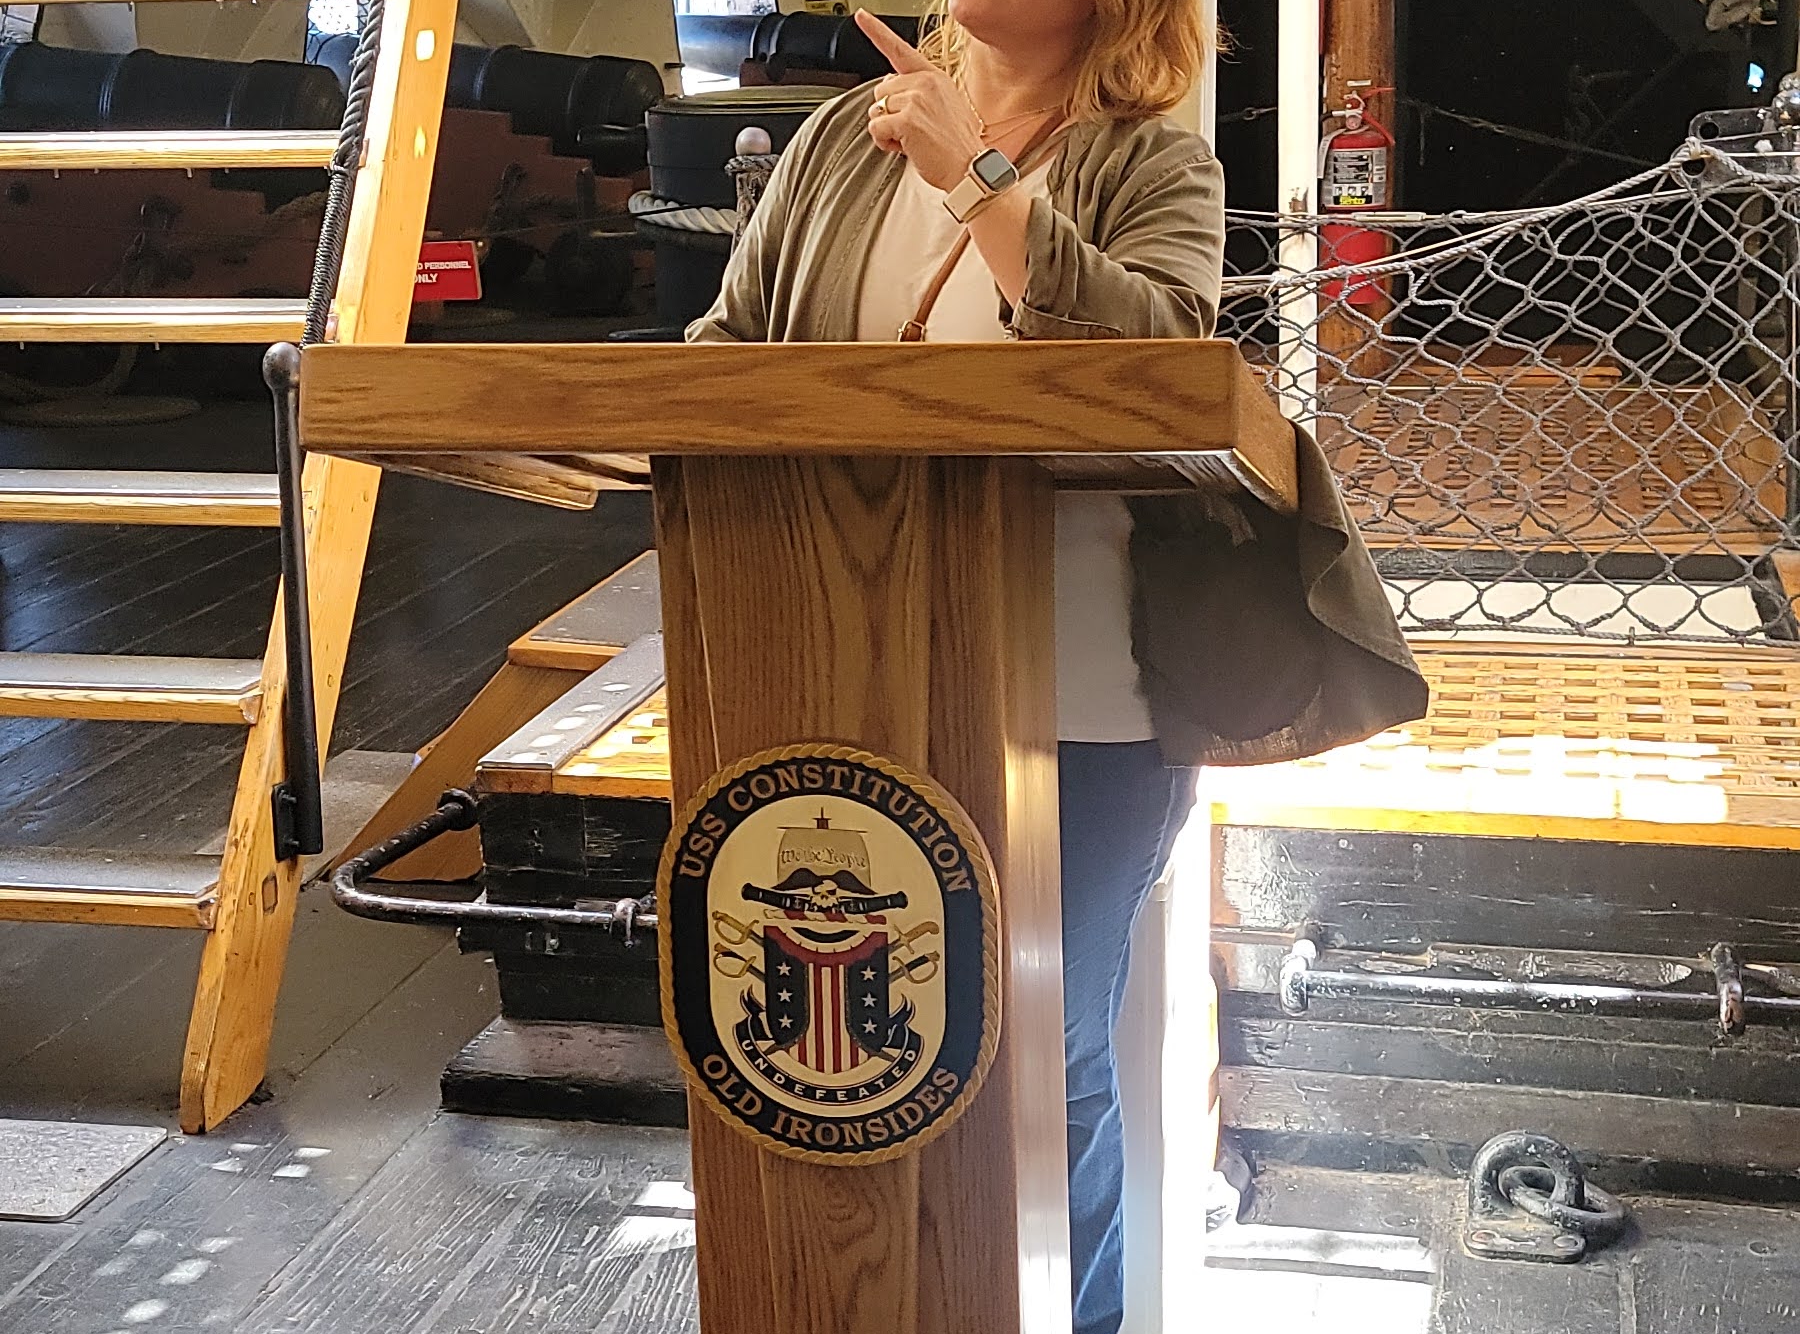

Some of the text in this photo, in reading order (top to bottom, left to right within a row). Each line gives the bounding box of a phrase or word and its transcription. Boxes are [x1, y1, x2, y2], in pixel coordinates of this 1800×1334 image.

[424, 261, 471, 269] PERSONNEL
[678, 763, 972, 892] USS CONSTITUTION
[780, 848, 800, 864] We
[822, 846, 866, 869] People
[702, 1053, 960, 1147] OLD IRONSIDES
[741, 1040, 917, 1102] UNDEFEATED
